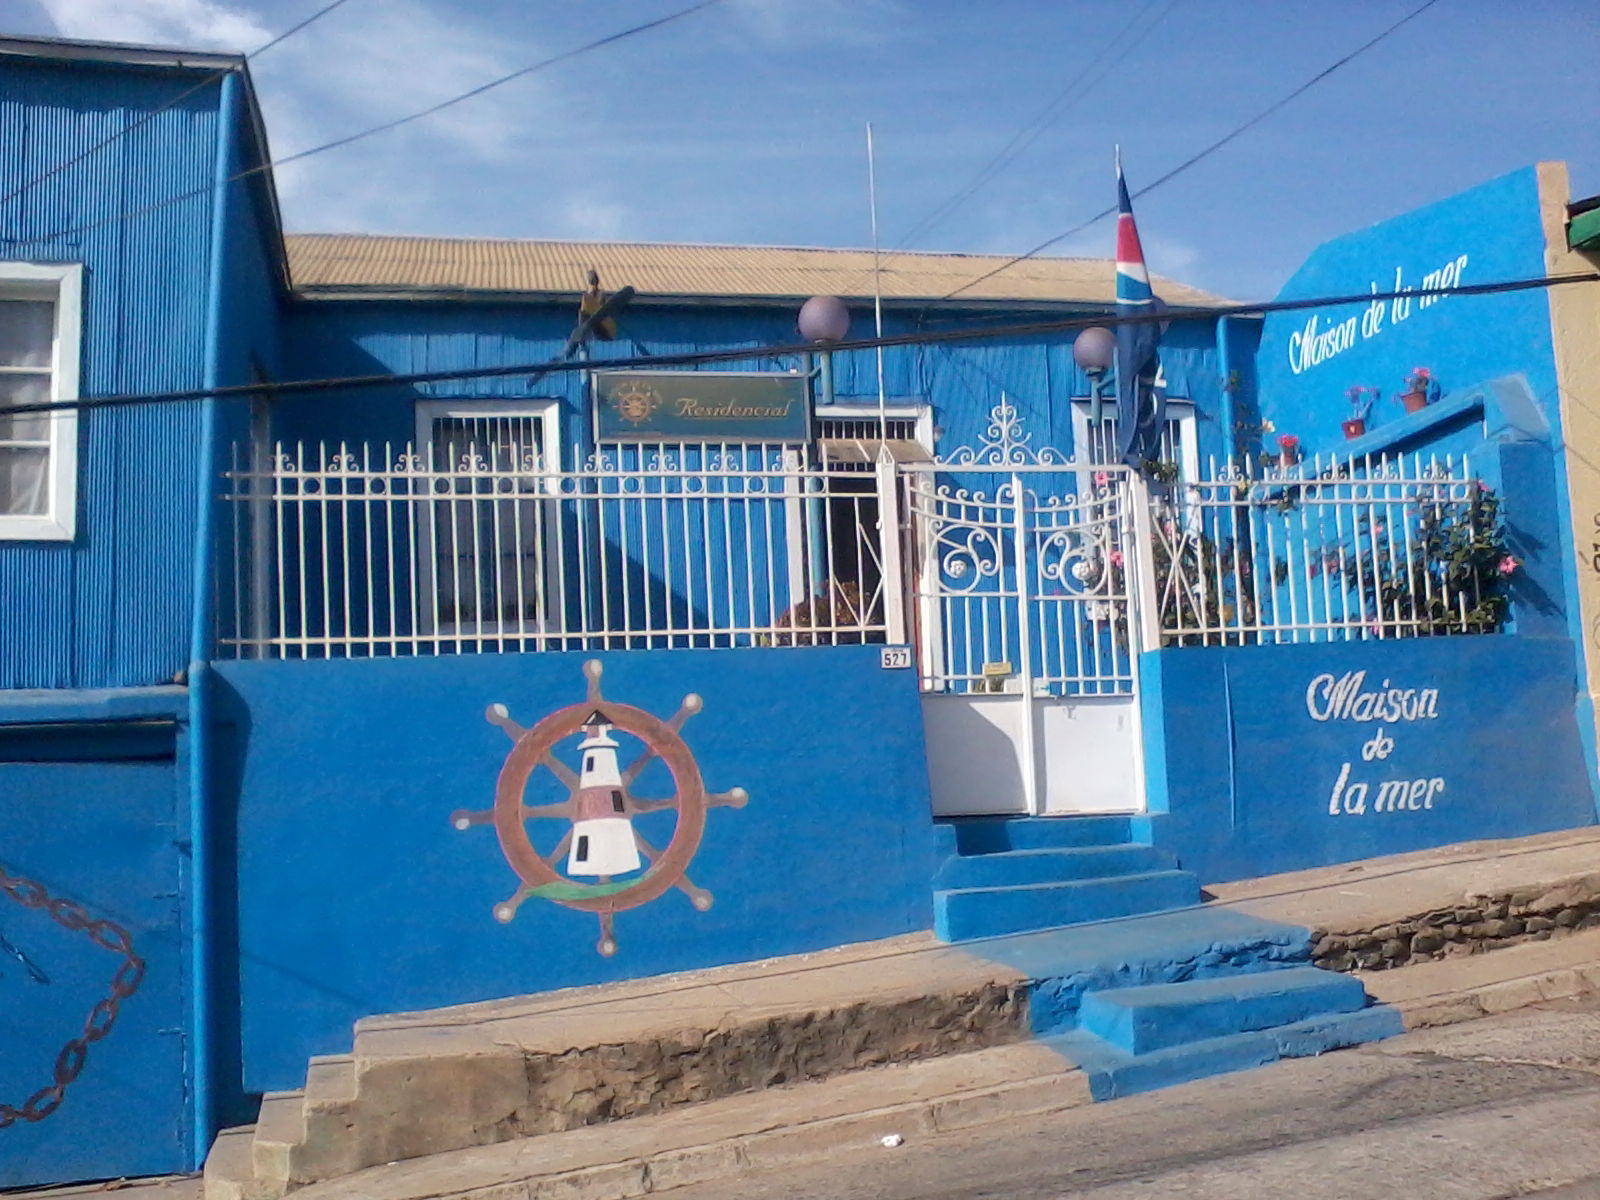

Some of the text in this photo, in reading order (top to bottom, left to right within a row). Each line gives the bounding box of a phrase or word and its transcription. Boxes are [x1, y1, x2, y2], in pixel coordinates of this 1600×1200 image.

[1289, 314, 1357, 375] Maison
[1362, 281, 1385, 339] de
[675, 397, 796, 418] Residencial
[884, 653, 907, 667] 527
[1306, 670, 1439, 723] Maison
[1362, 727, 1395, 761] de
[1329, 762, 1445, 816] la mer
